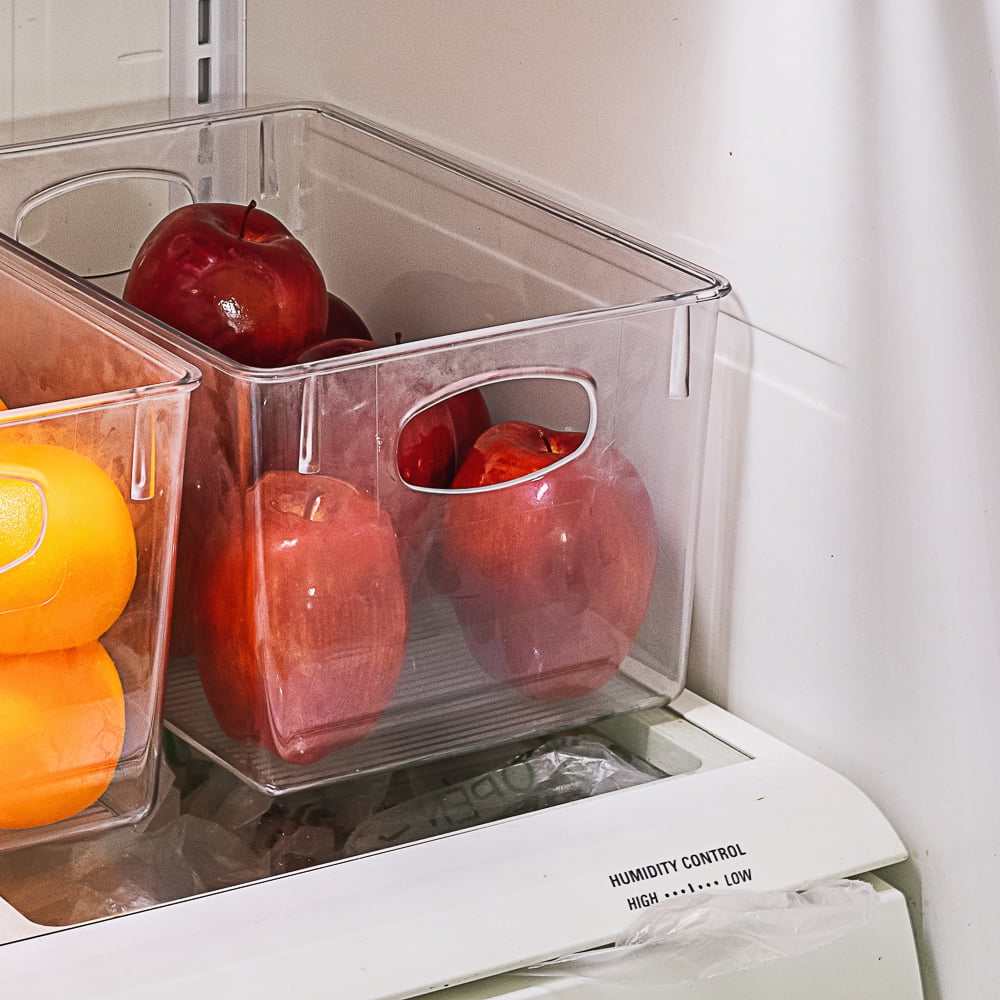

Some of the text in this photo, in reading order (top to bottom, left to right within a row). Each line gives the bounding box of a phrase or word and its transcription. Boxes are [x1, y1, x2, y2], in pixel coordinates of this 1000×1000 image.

[608, 843, 747, 888] HUMIDITY CONTROL
[626, 868, 753, 911] HIGH LOW
